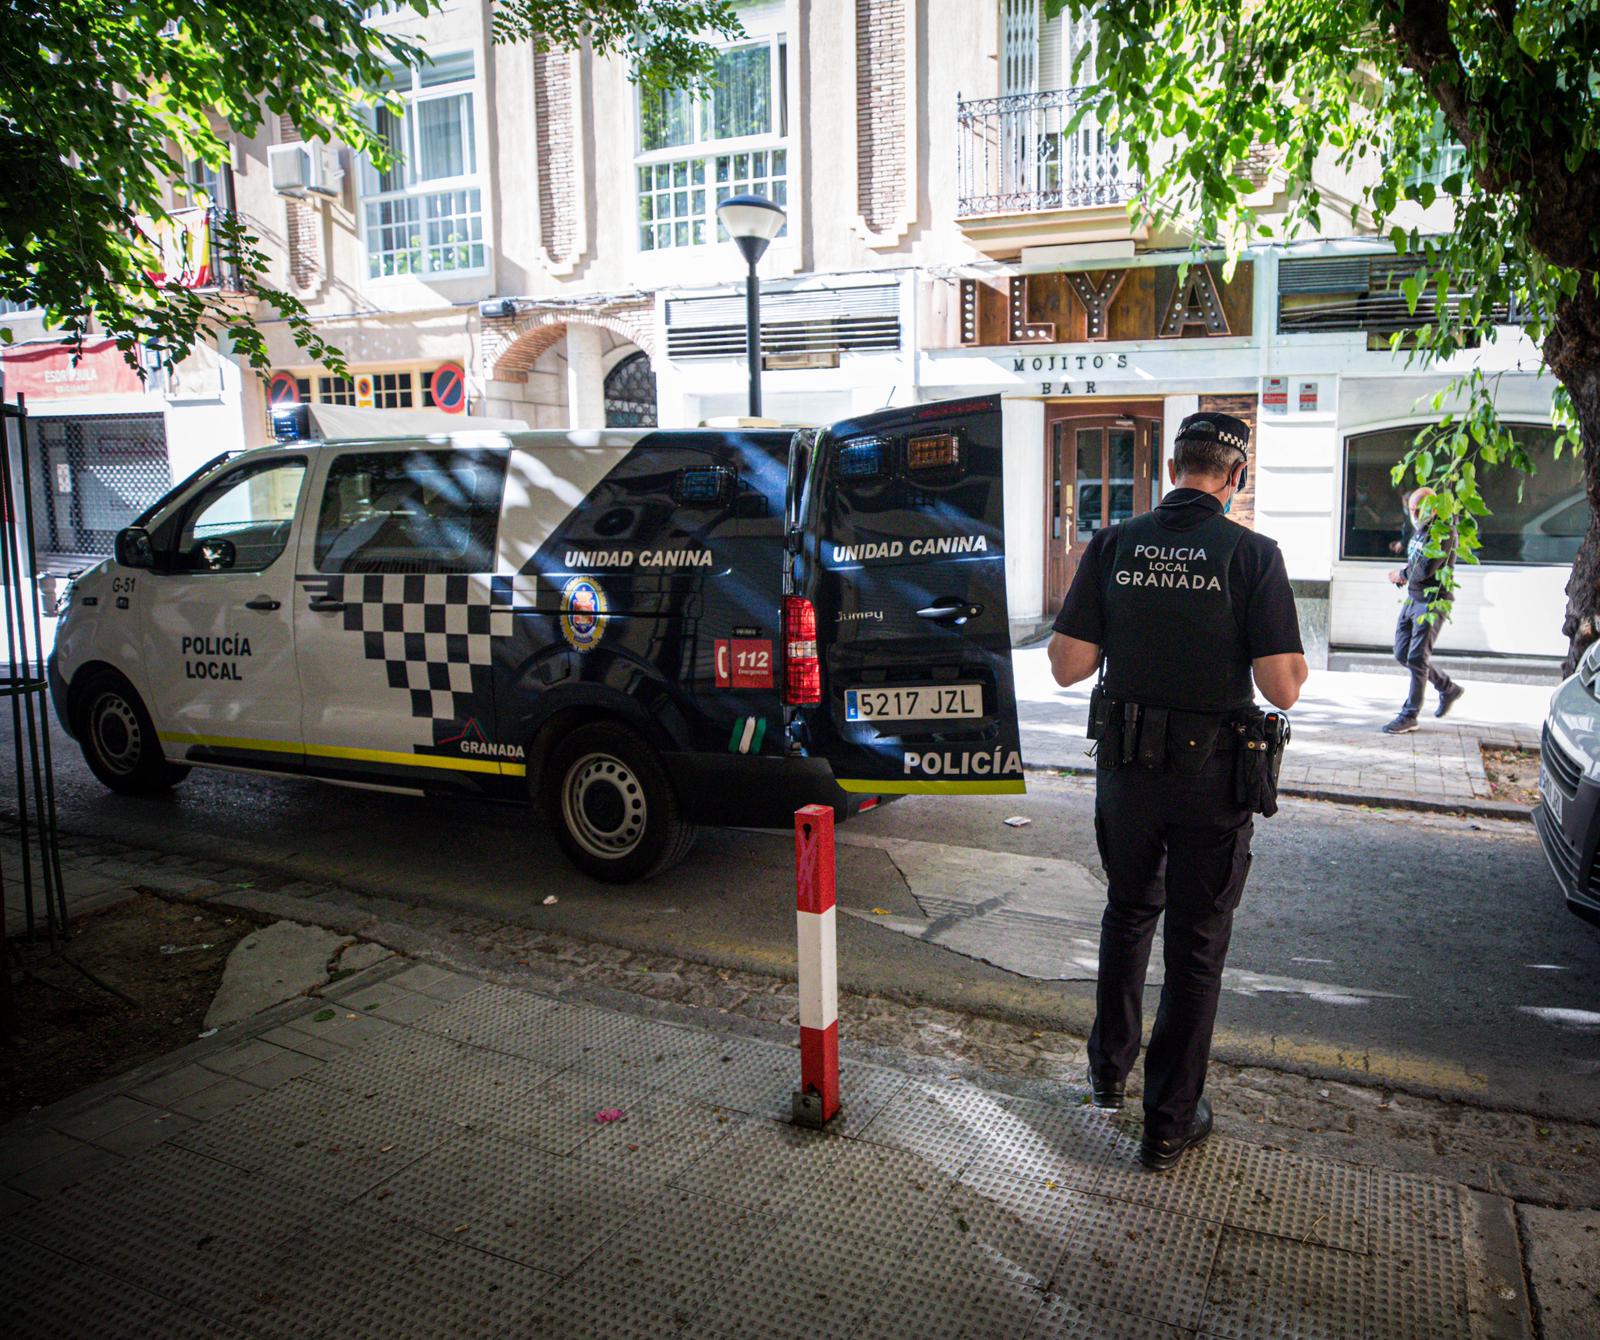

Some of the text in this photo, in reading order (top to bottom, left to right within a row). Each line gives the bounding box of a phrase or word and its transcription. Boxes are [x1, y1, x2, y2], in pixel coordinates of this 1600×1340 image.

[1013, 355, 1128, 373] MOJITO'S
[1041, 381, 1097, 395] BAR
[832, 535, 988, 562] UNIDAD CANINA
[1134, 544, 1208, 561] POLICIA
[564, 550, 713, 567] UNIDAD CANINA
[1149, 561, 1189, 573] LOCAL
[112, 577, 136, 593] G-51
[1115, 570, 1222, 592] GRANADA
[182, 633, 252, 657] POLICÍA
[737, 651, 769, 668] 112
[186, 661, 242, 681] LOCAL
[861, 690, 975, 716] 5217 JZL
[460, 740, 525, 758] GRANADA
[904, 746, 1023, 775] POLICÍA
